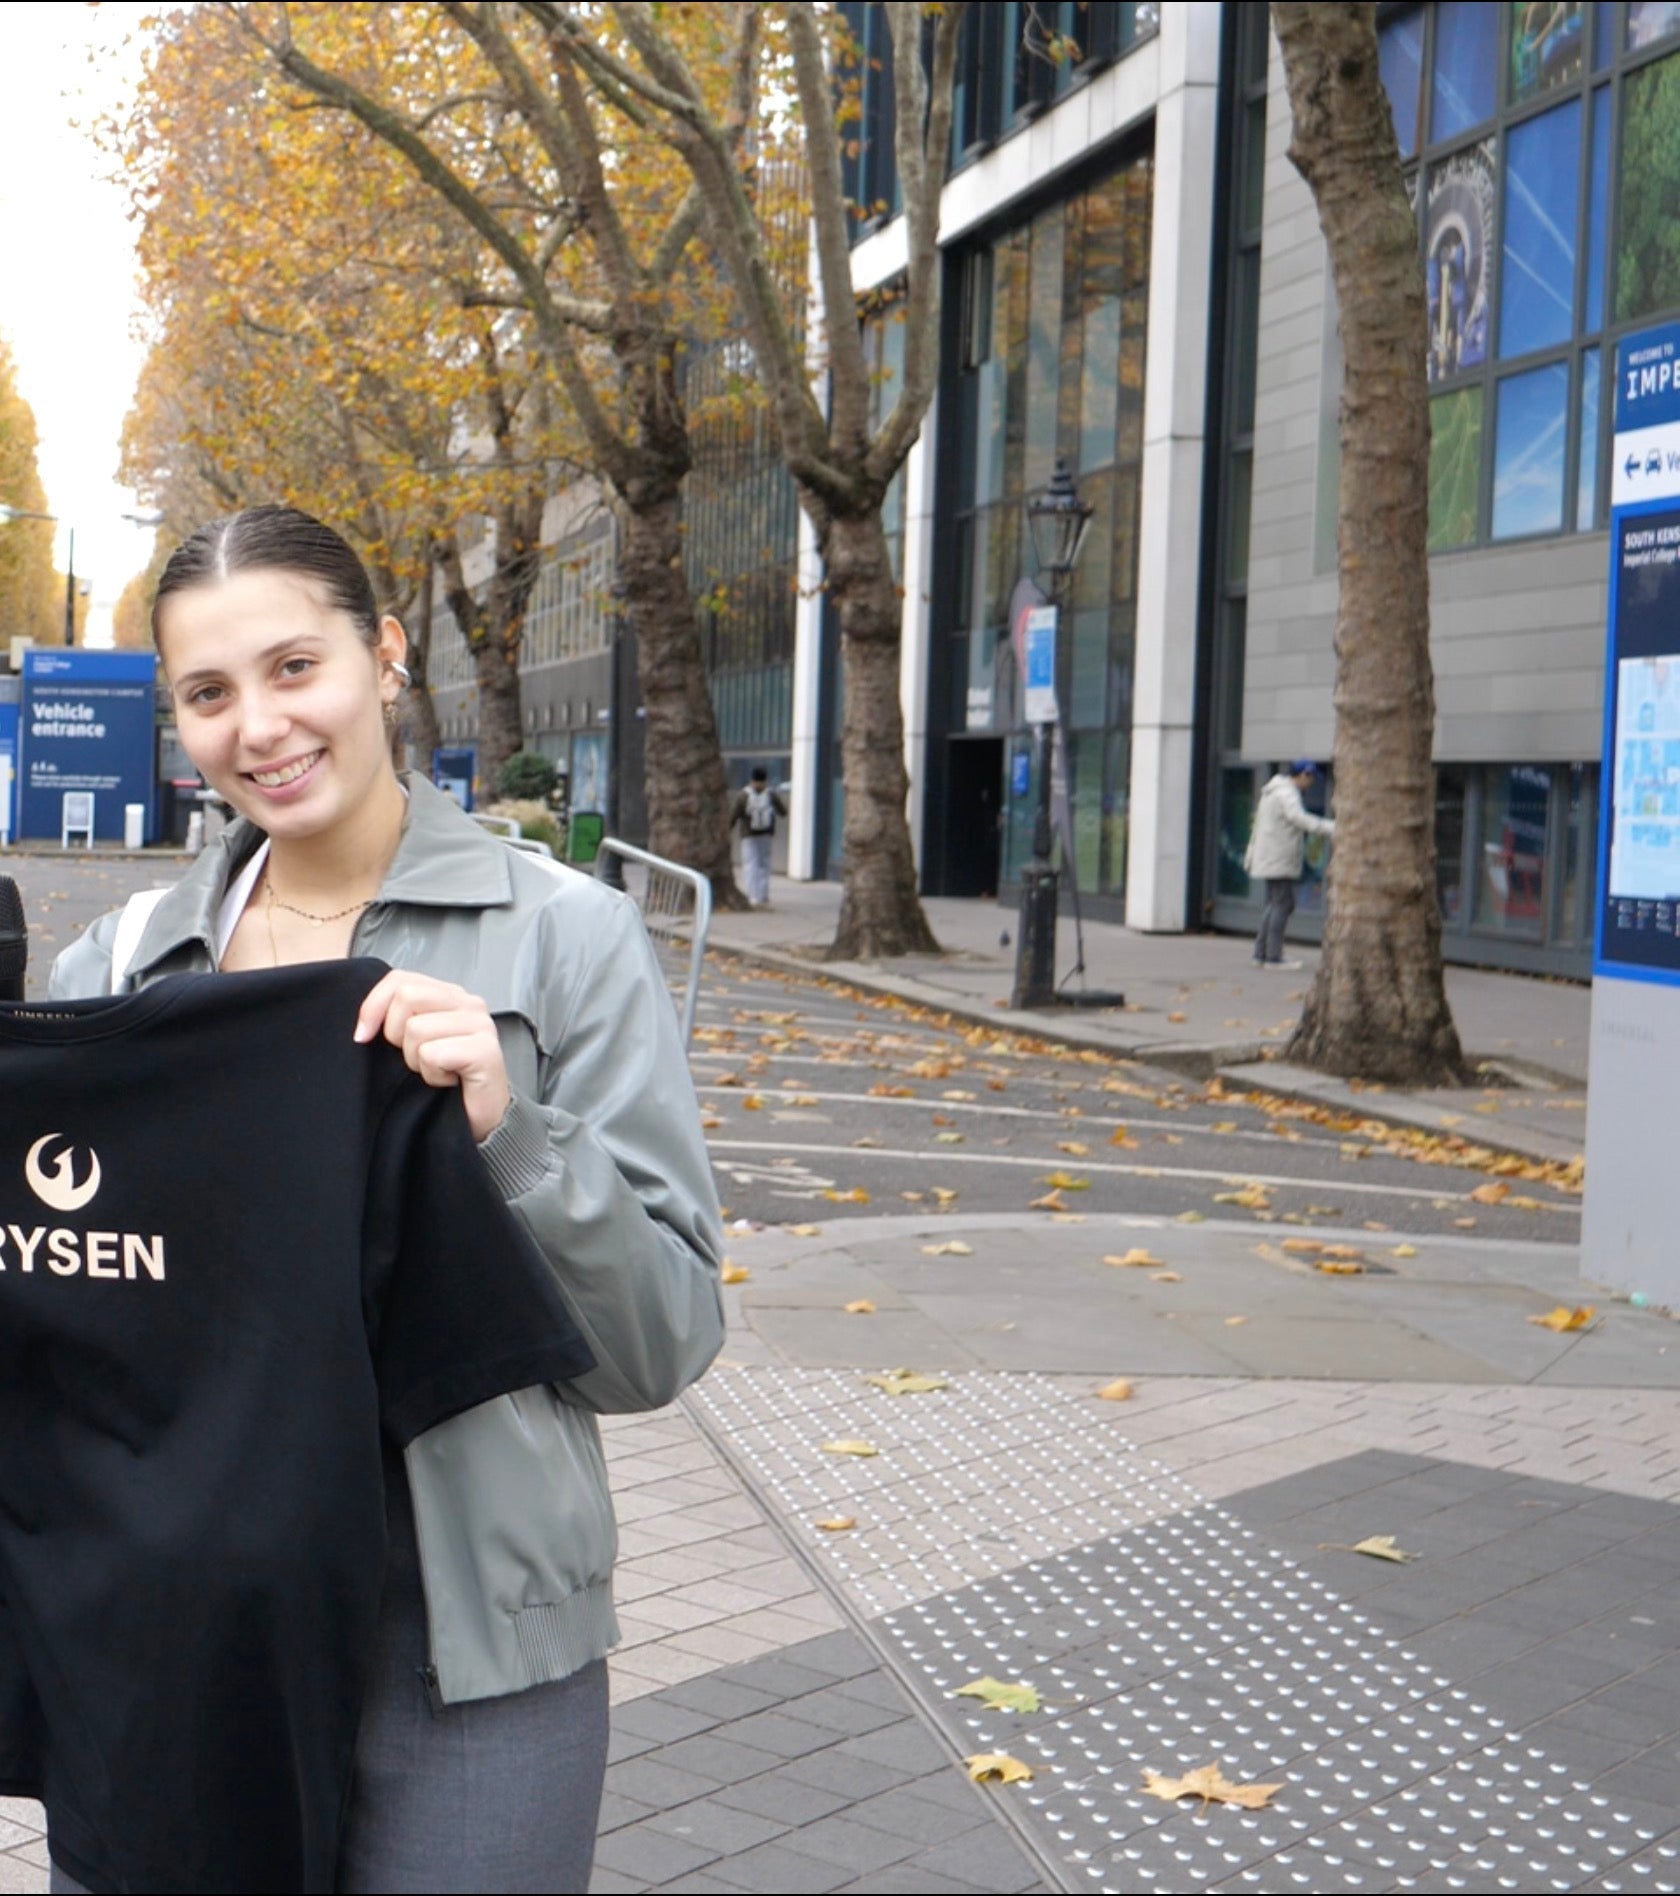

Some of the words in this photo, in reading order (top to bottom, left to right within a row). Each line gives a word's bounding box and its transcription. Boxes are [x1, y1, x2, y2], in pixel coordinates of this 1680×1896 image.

[1625, 530, 1655, 550] SOUTH
[32, 702, 95, 721] Vehicle
[31, 721, 106, 738] entrance
